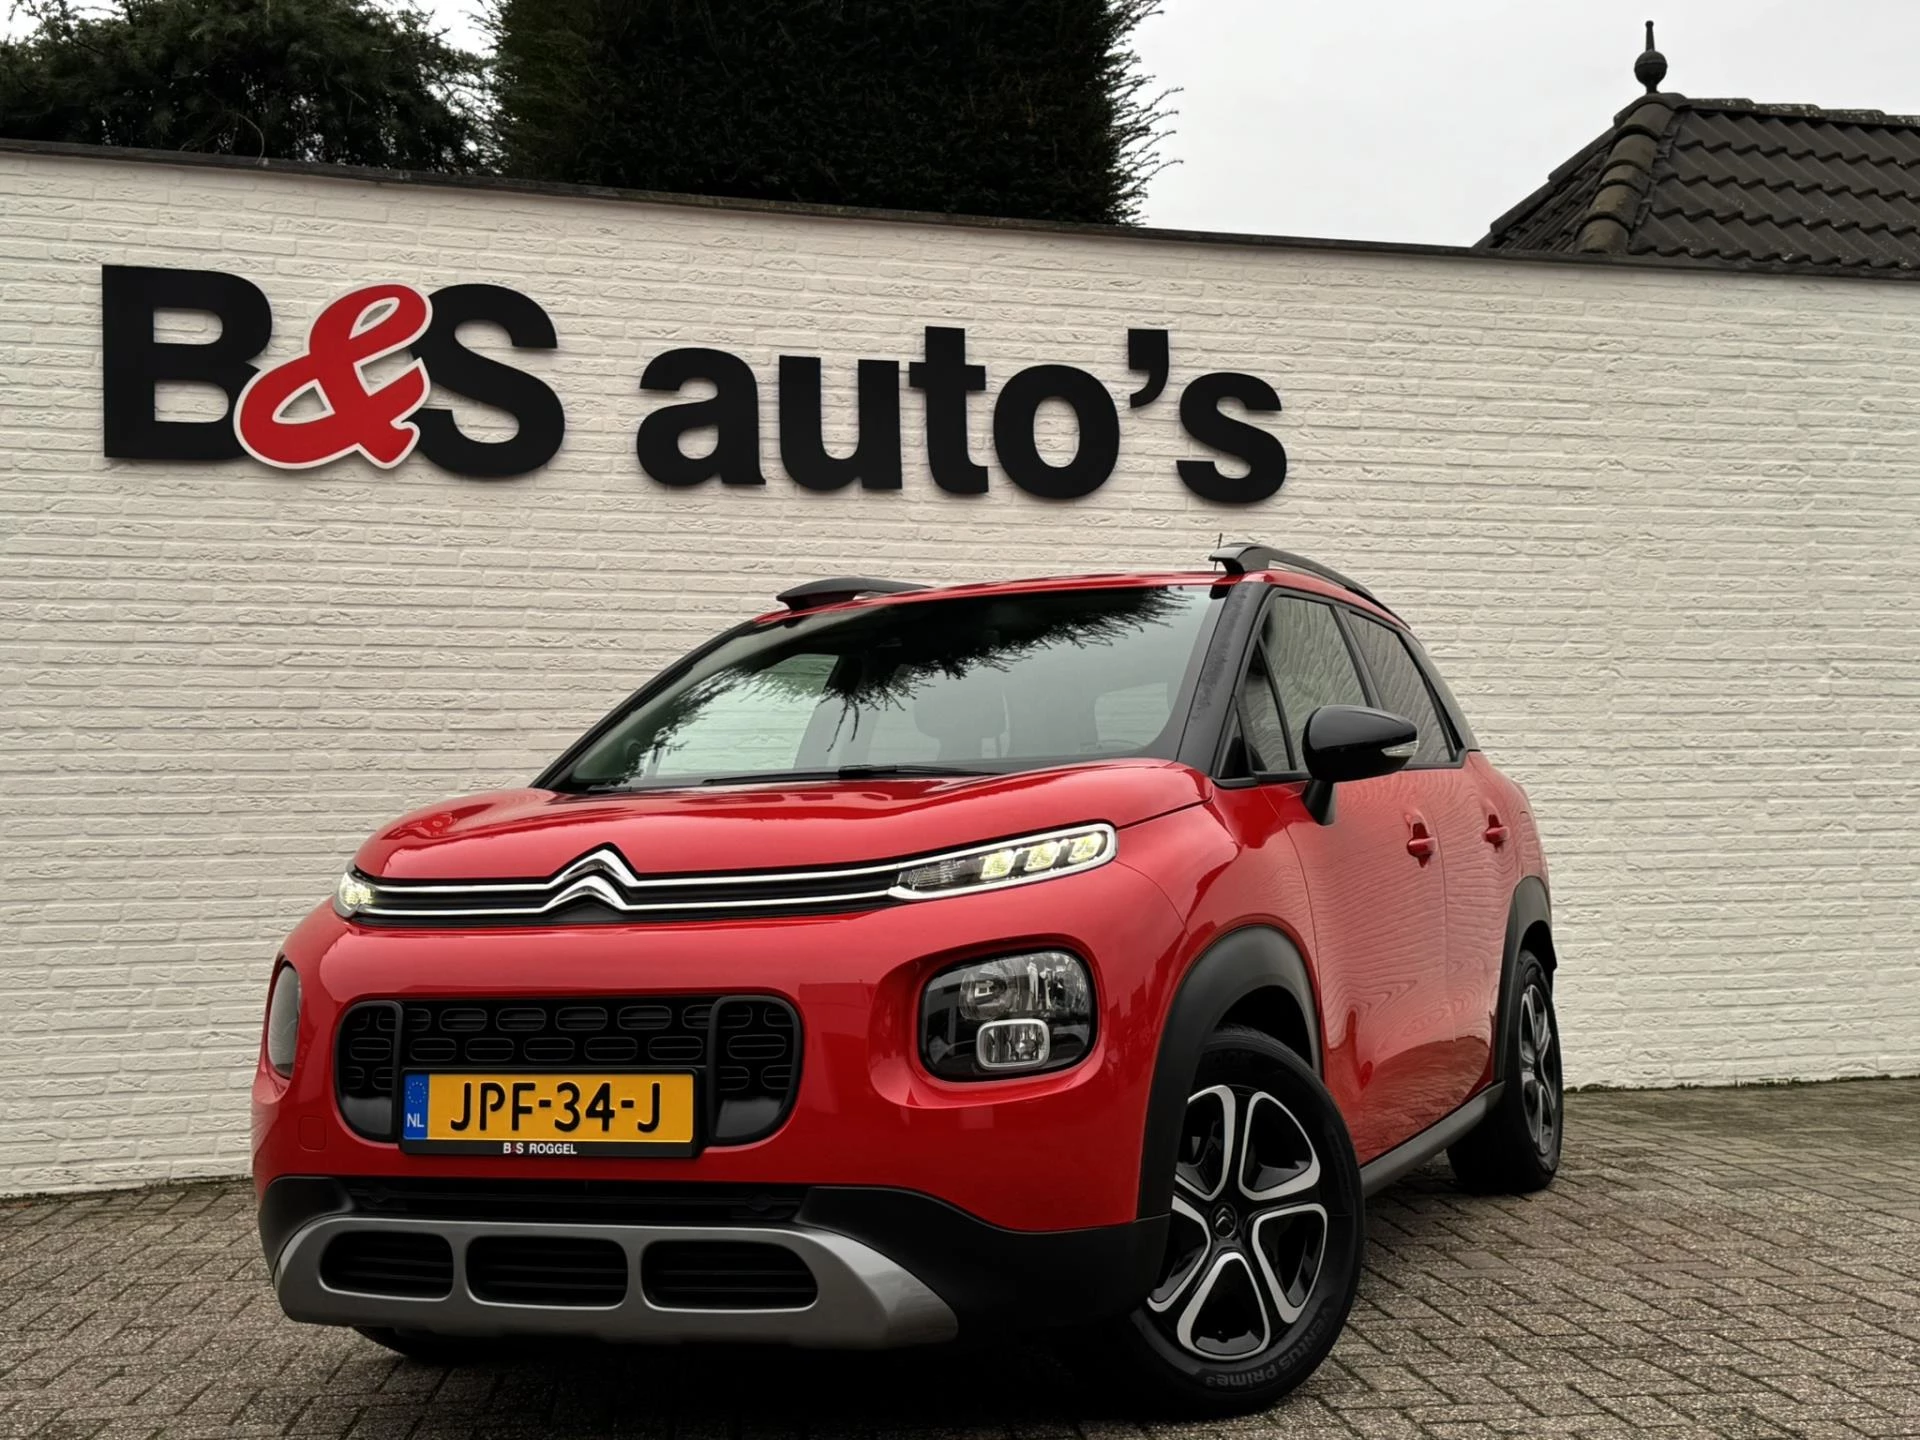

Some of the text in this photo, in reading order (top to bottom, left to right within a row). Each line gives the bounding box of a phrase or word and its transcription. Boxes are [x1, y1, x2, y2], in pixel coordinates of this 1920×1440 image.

[102, 263, 1288, 501] B&S auto’s
[406, 1112, 425, 1129] NL
[450, 1081, 661, 1133] JPF-34-J
[528, 1142, 578, 1155] ROGGEL
